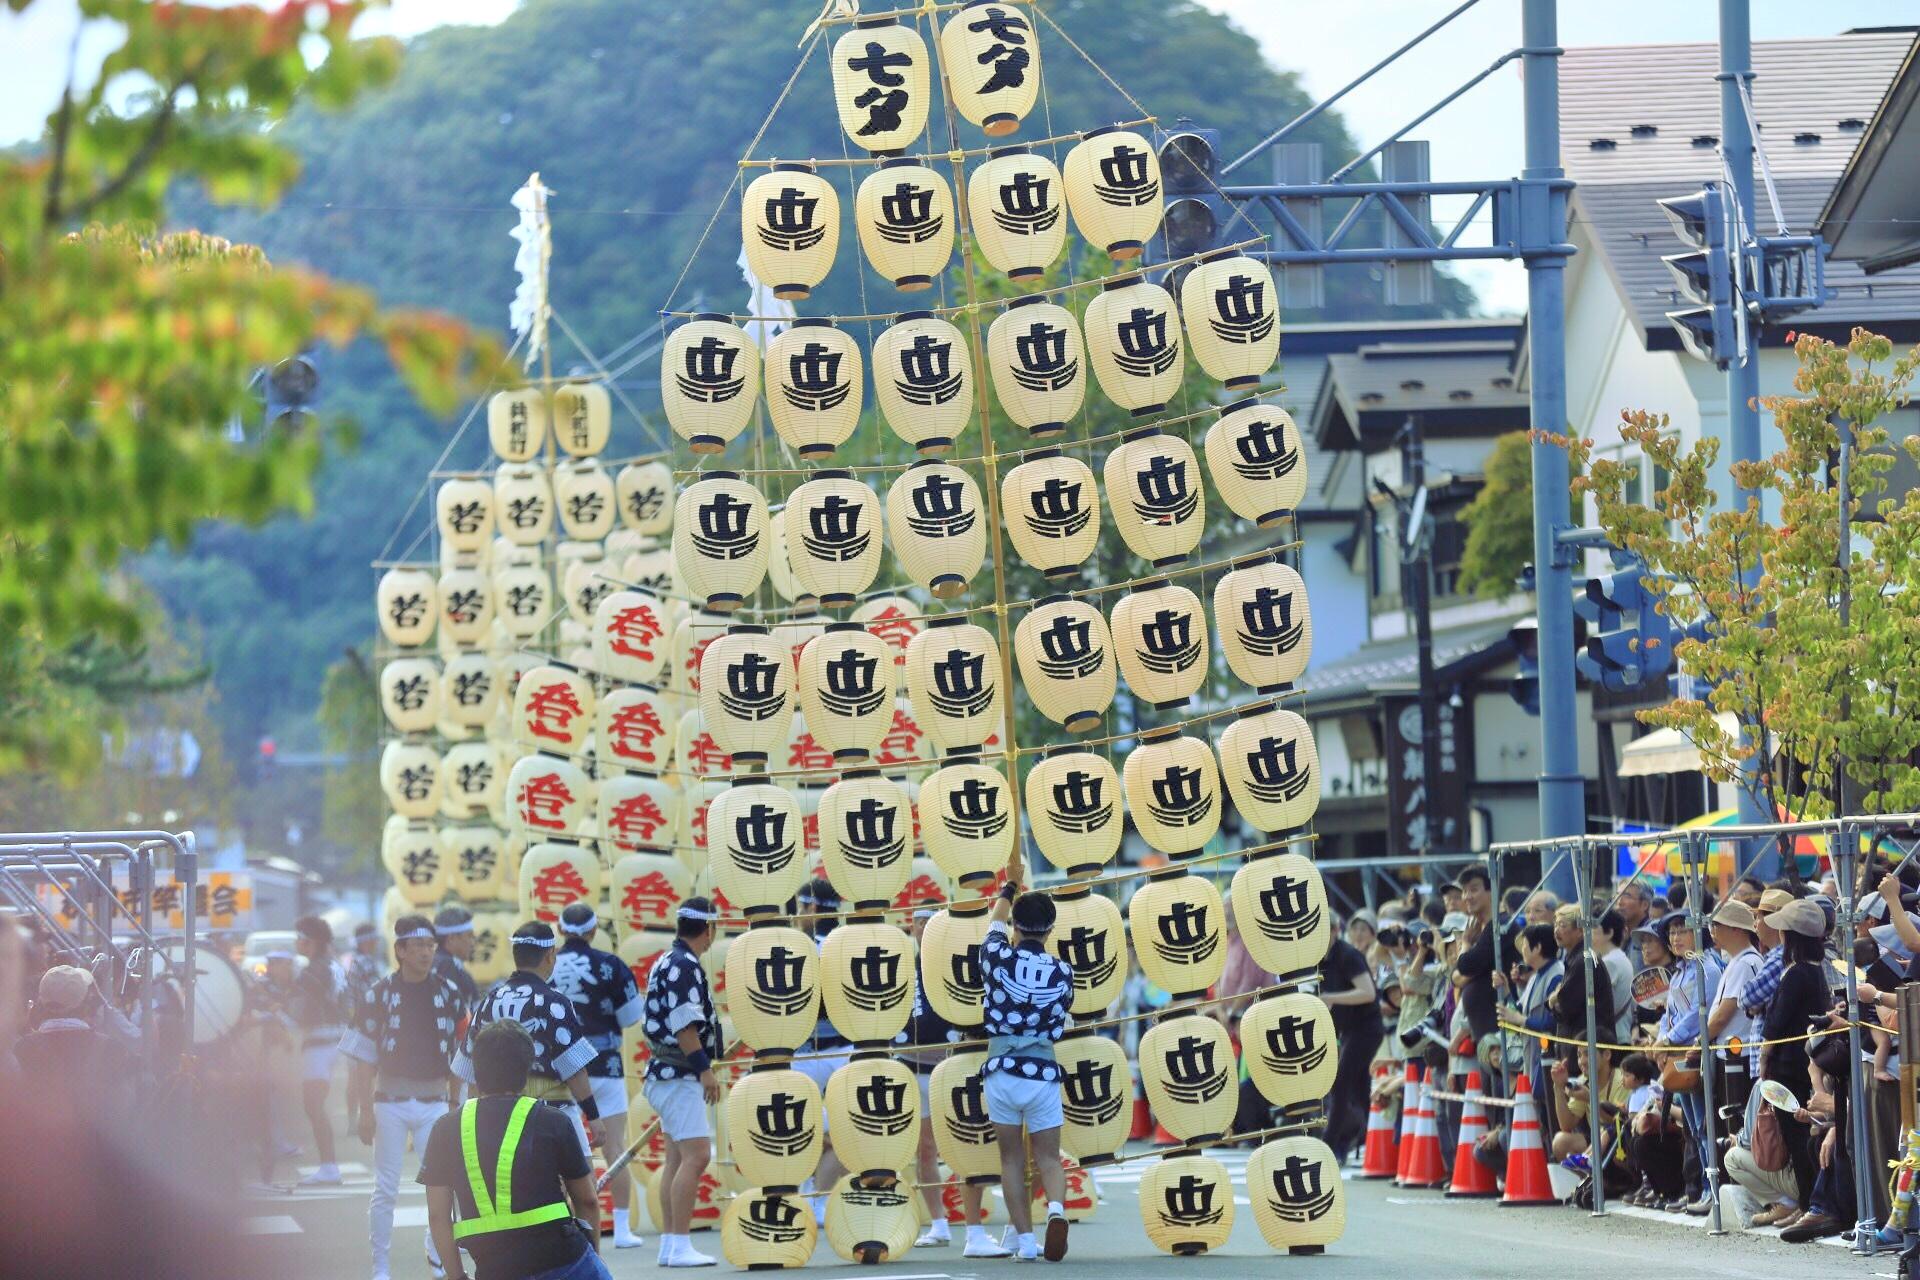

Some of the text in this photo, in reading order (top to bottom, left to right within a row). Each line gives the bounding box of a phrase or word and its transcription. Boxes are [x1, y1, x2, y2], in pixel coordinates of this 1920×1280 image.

[967, 7, 1030, 95] 七夕
[847, 41, 913, 137] 七夕
[448, 500, 486, 534] 若
[508, 496, 544, 529] 若
[567, 491, 604, 524] 若
[391, 593, 428, 628] 若
[507, 584, 543, 616] 若
[606, 604, 664, 663] 登
[393, 674, 430, 711] 若
[453, 671, 491, 706] 若
[525, 682, 584, 744] 登
[607, 702, 666, 764] 登
[398, 763, 436, 801] 若
[457, 760, 494, 794] 若
